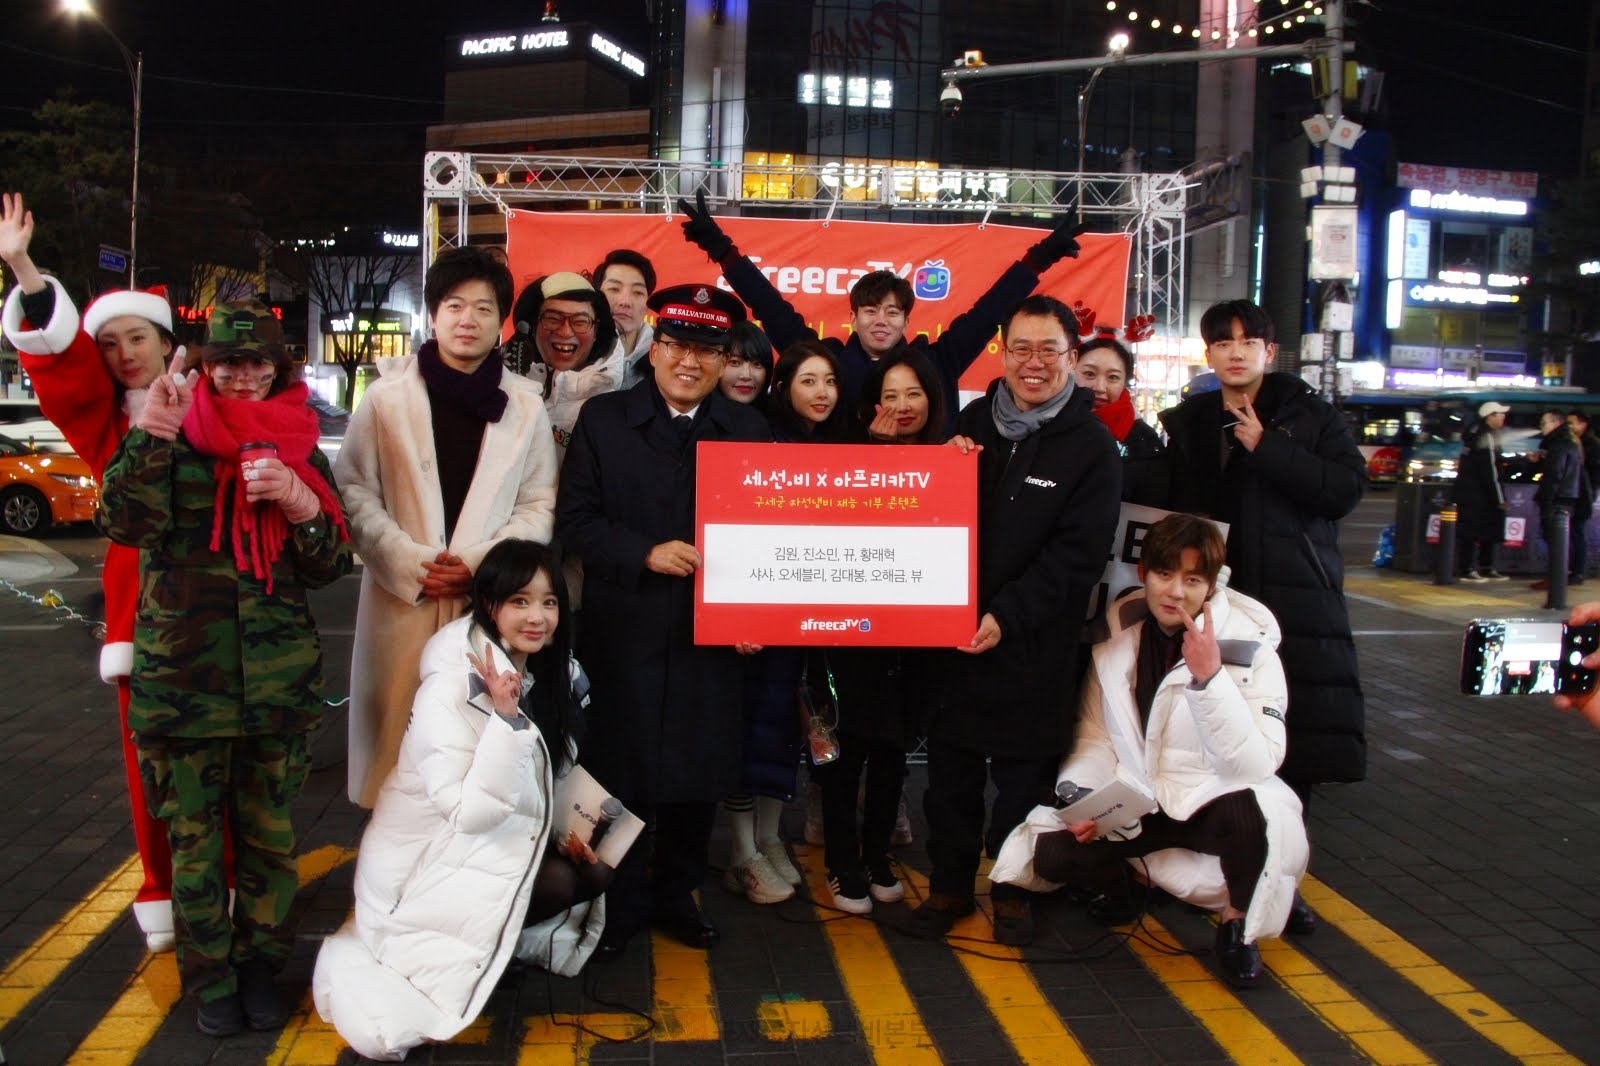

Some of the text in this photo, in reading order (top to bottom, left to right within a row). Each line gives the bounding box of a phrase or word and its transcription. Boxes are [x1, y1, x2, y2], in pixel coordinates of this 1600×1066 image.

[462, 31, 569, 56] PACIFIC HOTEL
[591, 33, 645, 77] PACIFIC HOTEL
[667, 307, 677, 315] THE
[678, 309, 716, 320] SALVATION
[834, 469, 931, 489] 아프리카TV
[754, 496, 919, 510] 구세군 자선냄비 재능 기부 콘텐츠
[774, 546, 800, 562] 김원,
[803, 547, 840, 562] 진소민,
[860, 548, 895, 562] 황래혁
[750, 567, 924, 583] 샤샤, 오세블리, 김대봉, 오해금, 뷰
[800, 618, 859, 631] afreecaTV
